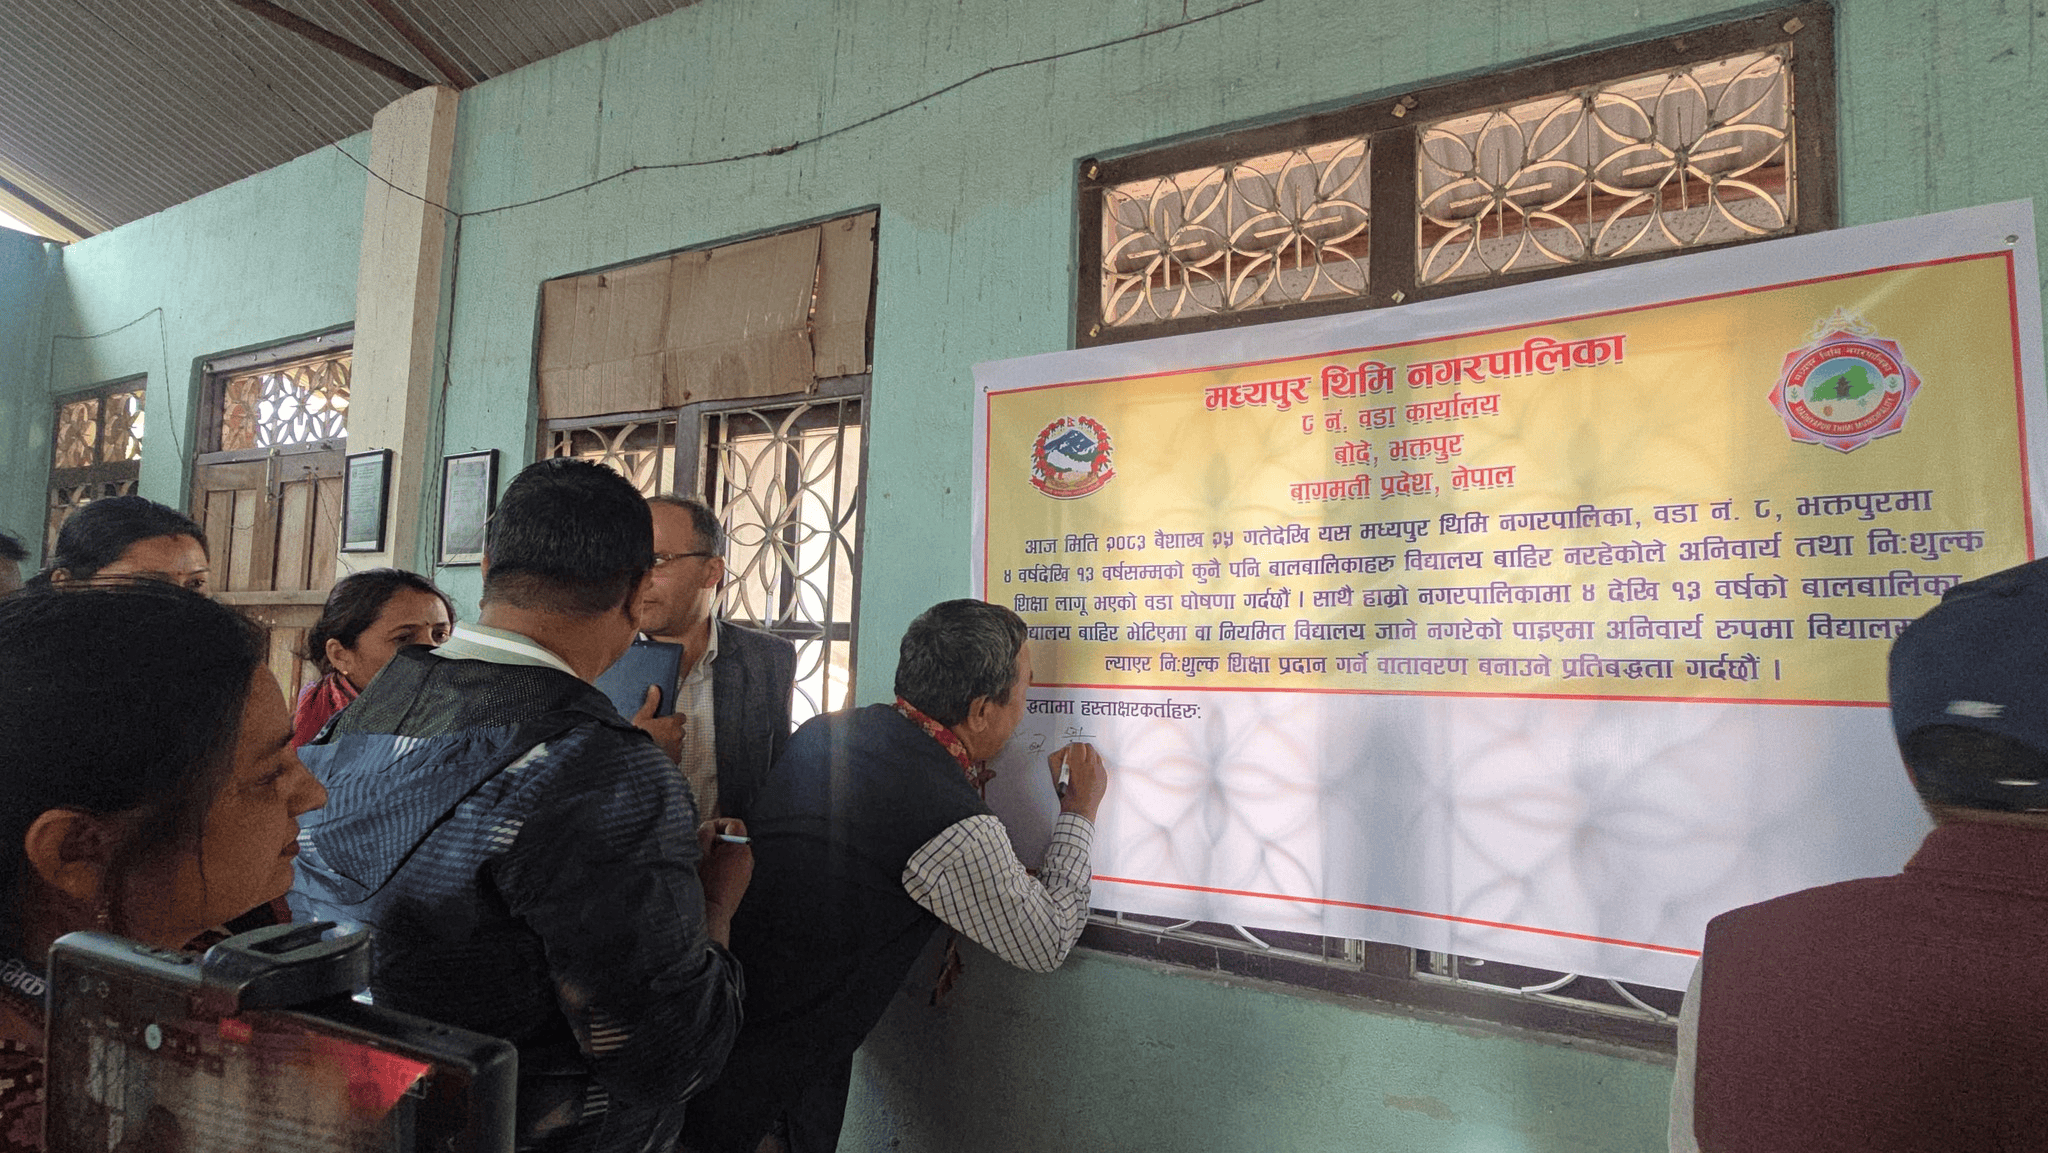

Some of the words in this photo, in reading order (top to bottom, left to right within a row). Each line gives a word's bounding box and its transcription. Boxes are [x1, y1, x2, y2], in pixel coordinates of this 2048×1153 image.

[1205, 376, 1312, 410] मध्यपुर
[1321, 361, 1396, 399] थिमि
[1406, 334, 1626, 387] नगरपालिका
[1358, 406, 1396, 429] वडा
[1405, 392, 1500, 424] कार्यालय
[1334, 440, 1378, 466] बोदे,
[1389, 434, 1464, 462] भक्तपुर
[1290, 474, 1371, 502] बागमती
[1381, 470, 1440, 499] प्रदेश,
[1451, 465, 1516, 490] नेपाल
[1025, 539, 1058, 554] आज
[1064, 533, 1099, 552] मिति
[1106, 535, 1146, 552] २०८३
[1154, 529, 1204, 549] बैशाख
[1243, 524, 1310, 545] गतेदेखि
[1318, 525, 1352, 541] यस
[1360, 520, 1430, 542] मध्यपुर
[1439, 512, 1489, 535] थिमि
[1499, 504, 1641, 531] नगरपालिका,
[1653, 503, 1699, 523] वडा
[1796, 490, 1933, 521] भक्तपुरमा
[1004, 569, 1011, 583] ४
[1018, 563, 1070, 583] वर्षदेखि
[1077, 567, 1094, 583] १३
[1102, 560, 1185, 581] वर्षसम्मको
[1192, 558, 1221, 584] कुनै
[1229, 558, 1261, 577] पनि
[1268, 554, 1396, 576] बालबालिकाहरु
[1404, 549, 1483, 571] विद्यालय
[1493, 544, 1553, 568] बाहिर
[1563, 539, 1667, 566] नरहेकोले
[1679, 531, 1782, 561] अनिवार्य
[1794, 535, 1854, 557] तथा
[1014, 593, 1049, 612] शिक्षा
[1055, 596, 1088, 616] लागू
[1094, 592, 1137, 612] भएको
[1145, 595, 1173, 610] वडा
[1181, 591, 1236, 610] घोषणा
[1243, 586, 1292, 609] गर्दछौं
[1313, 584, 1354, 607] साथै
[1362, 584, 1409, 608] हाम्रो
[1418, 581, 1571, 605] नगरपालिकामा
[1582, 584, 1595, 602] ४
[1607, 577, 1660, 602] देखि
[1672, 581, 1701, 602] १३
[1714, 573, 1788, 600] वर्षको
[1028, 625, 1072, 640] द्यालय
[1078, 622, 1119, 641] बाहिर
[1127, 622, 1187, 642] भेटिएमा
[1195, 625, 1213, 641] वा
[1219, 620, 1286, 641] नियमित
[1294, 619, 1366, 640] विद्यालय
[1374, 618, 1418, 640] जाने
[1427, 618, 1503, 640] नगरेको
[1512, 621, 1595, 642] पाइएमा
[1606, 613, 1704, 640] अनिवार्य
[1715, 619, 1795, 639] रुपमा
[1105, 655, 1152, 673] ल्याएर
[1227, 652, 1271, 673] शिक्षा
[1278, 656, 1327, 675] प्रदान
[1336, 651, 1369, 674] गर्ने
[1377, 657, 1468, 675] वातावरण
[1477, 654, 1552, 677] बनाउने
[1562, 653, 1674, 680] प्रतिबद्धता
[1685, 653, 1760, 681] गर्दछौं
[1026, 699, 1075, 714] द्धतामा
